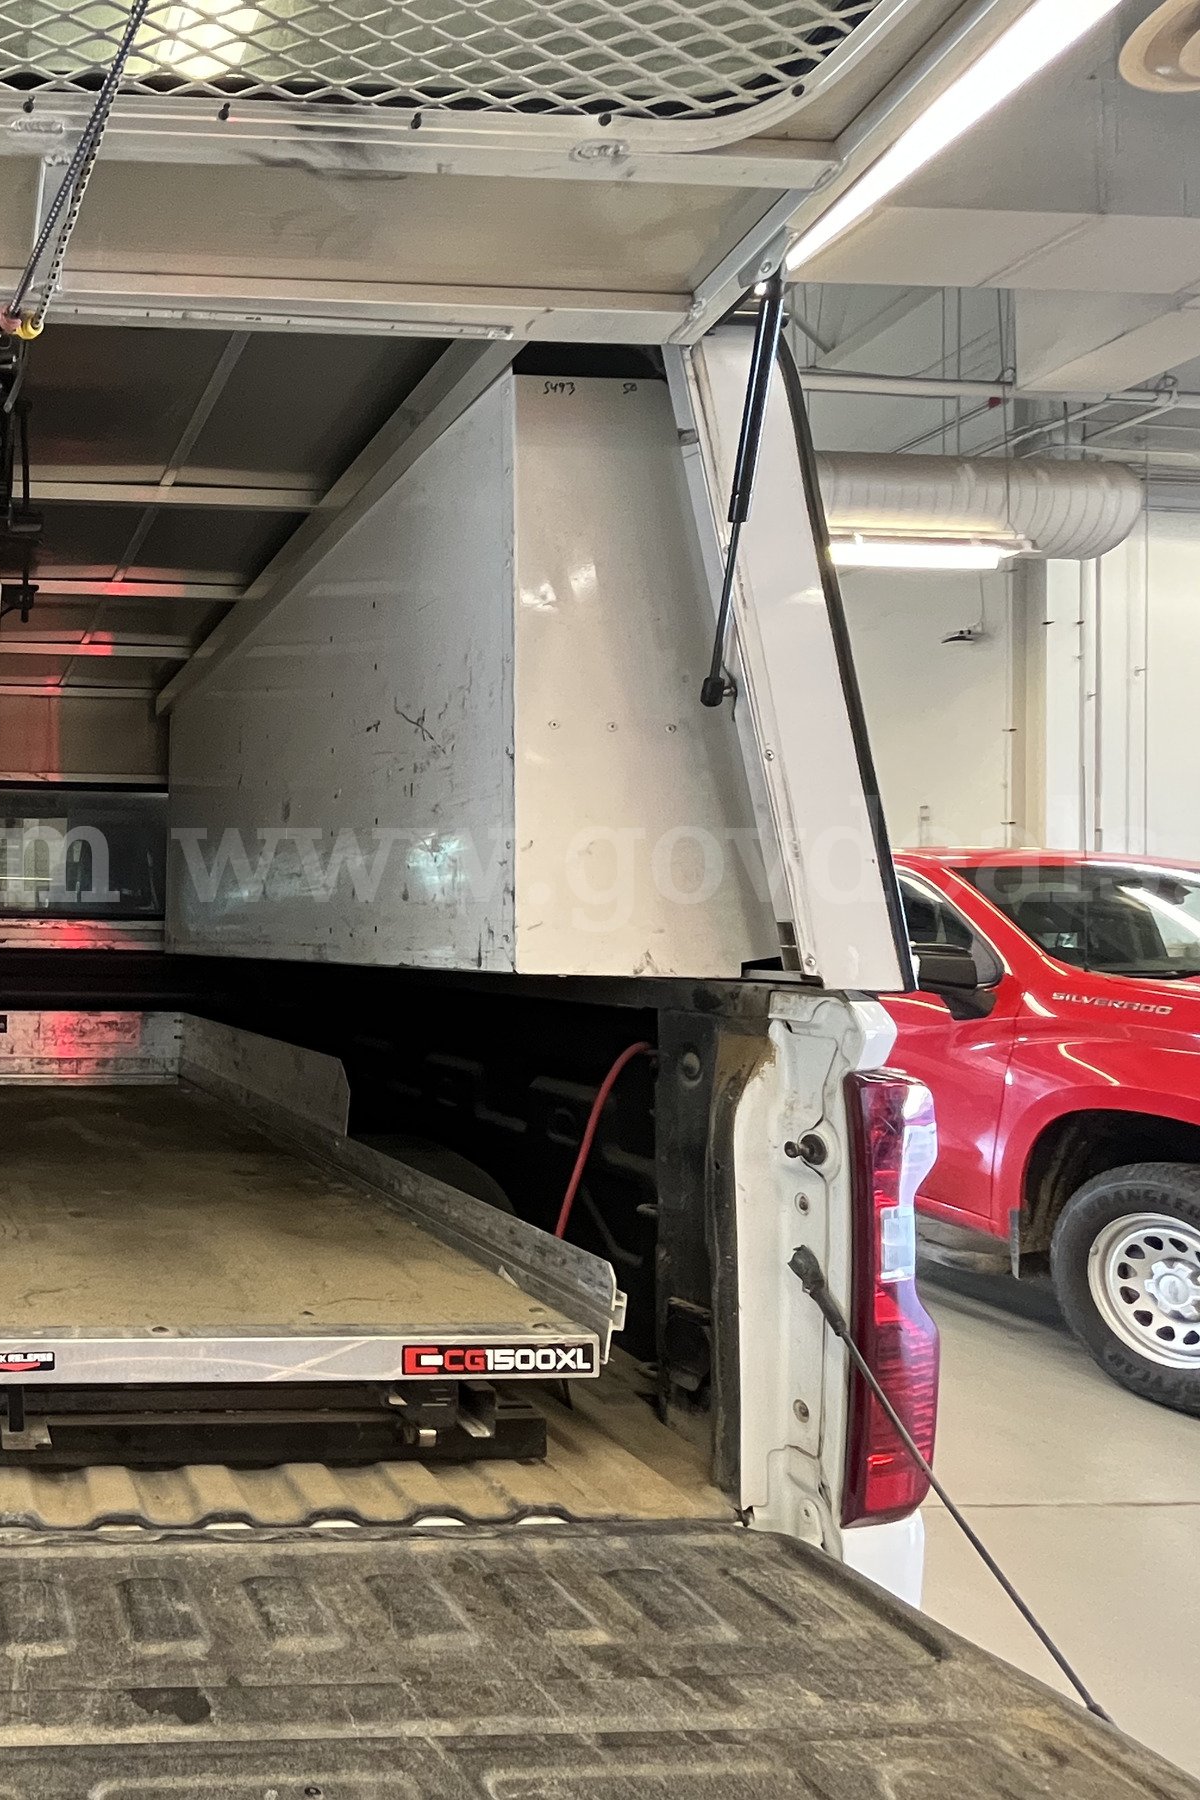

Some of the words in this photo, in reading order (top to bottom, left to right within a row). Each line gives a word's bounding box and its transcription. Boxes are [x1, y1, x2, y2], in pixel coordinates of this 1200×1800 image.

[543, 381, 576, 395] 5493
[1052, 992, 1173, 1015] SILVERADO
[444, 1348, 591, 1370] CG1500XL
